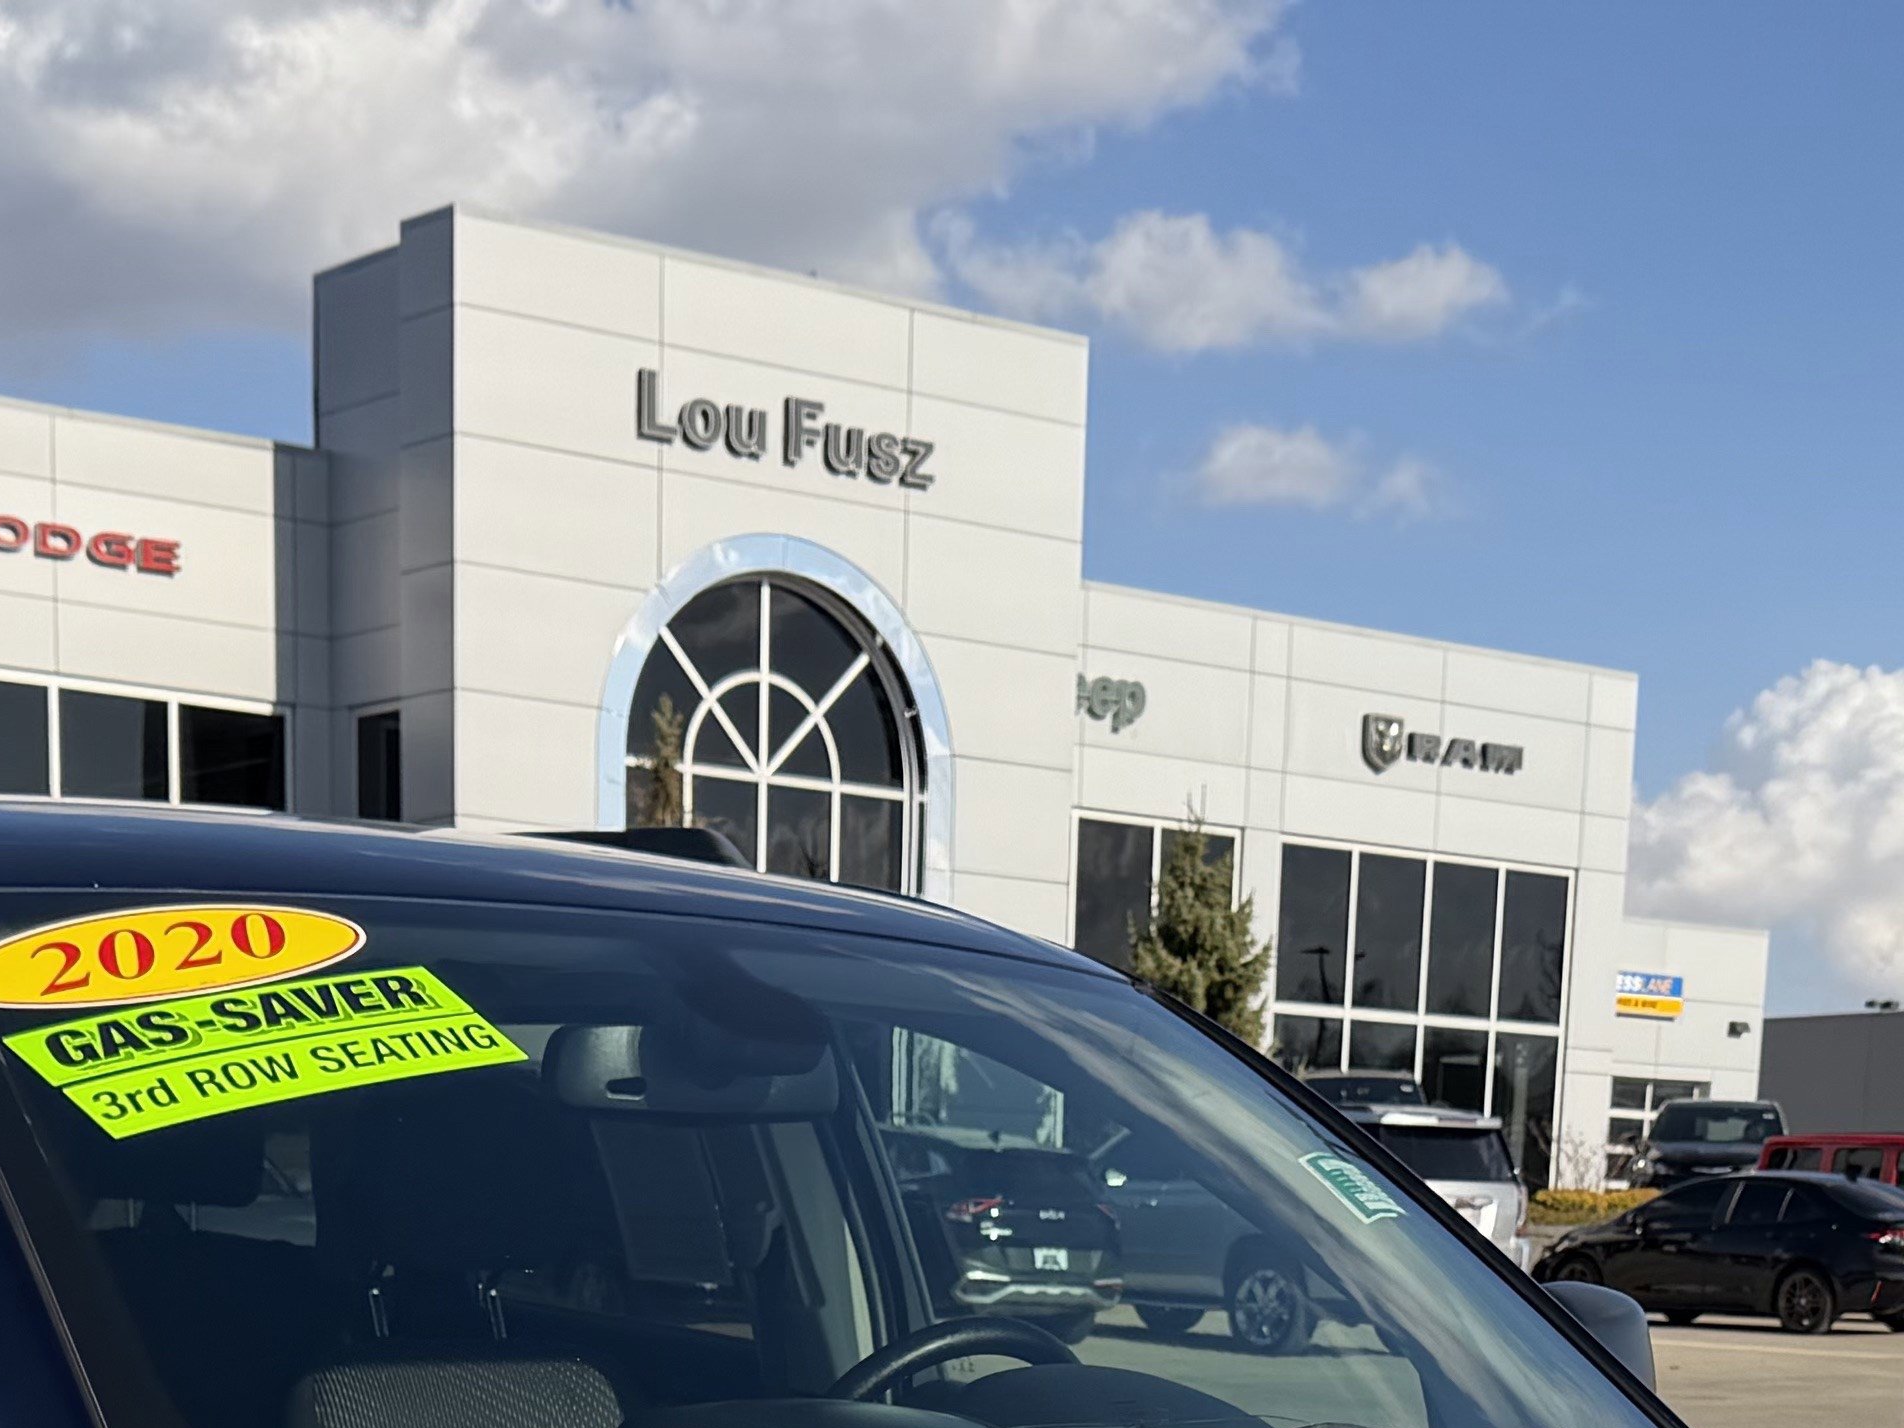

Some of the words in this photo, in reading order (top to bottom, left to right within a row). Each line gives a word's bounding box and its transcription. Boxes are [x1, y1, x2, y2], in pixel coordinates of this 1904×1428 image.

[636, 367, 767, 461] Lou
[783, 395, 936, 491] Fusz
[1406, 732, 1523, 775] RAM
[29, 911, 286, 997] 2020
[44, 973, 431, 1073] GAS-SAVER
[91, 1078, 179, 1122] 3rd
[186, 1052, 300, 1099] ROW
[316, 1023, 501, 1075] SEATING
